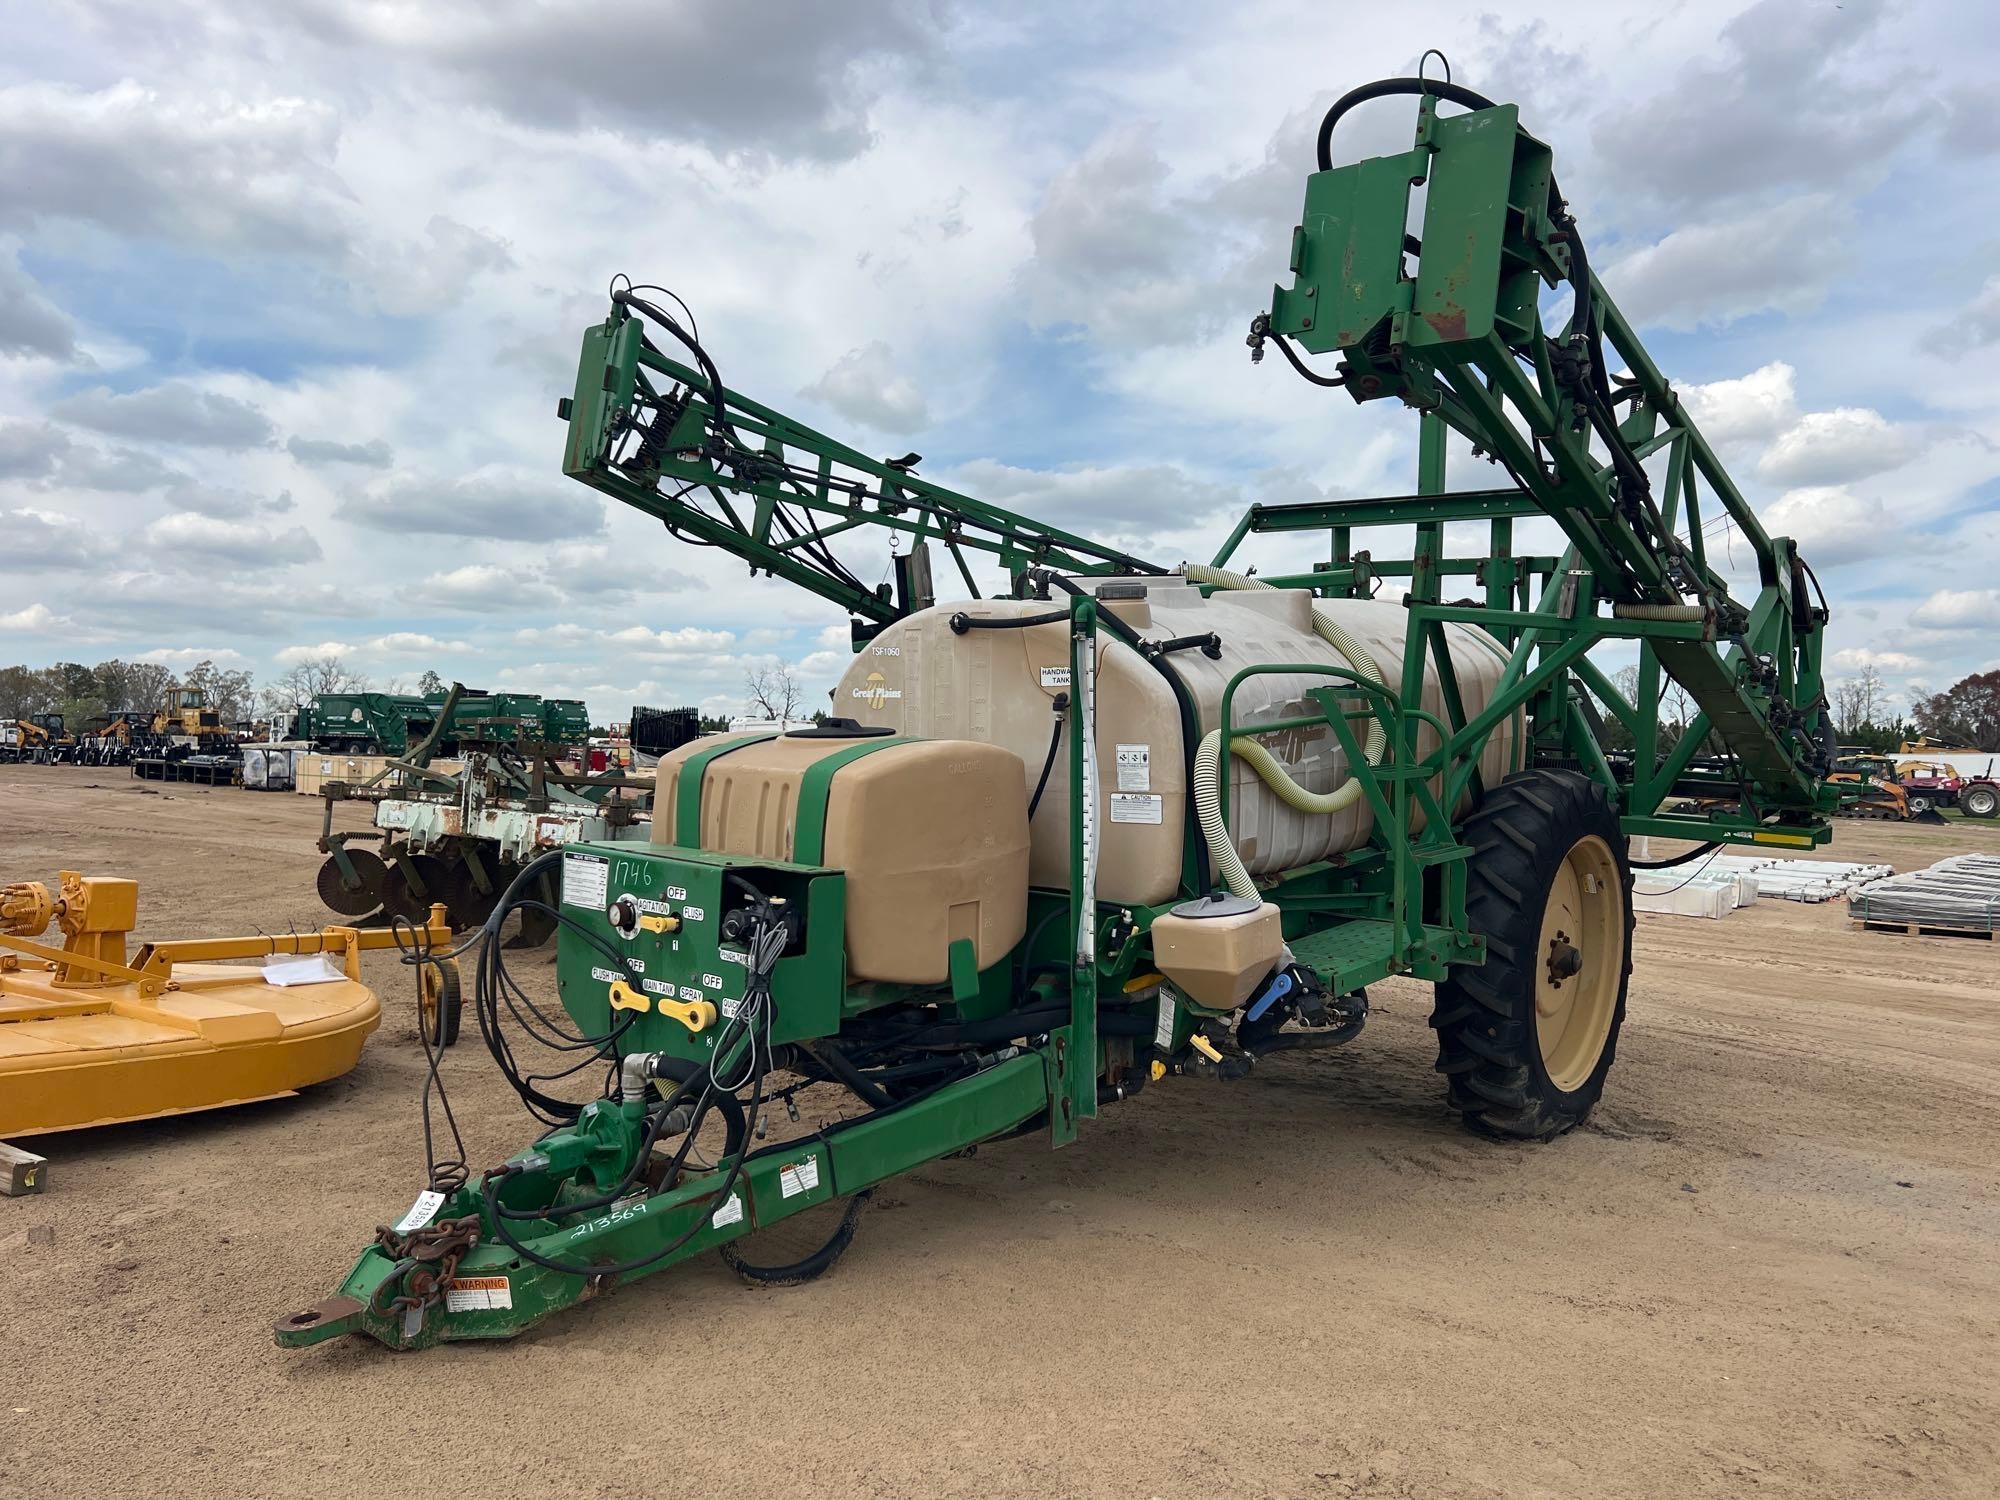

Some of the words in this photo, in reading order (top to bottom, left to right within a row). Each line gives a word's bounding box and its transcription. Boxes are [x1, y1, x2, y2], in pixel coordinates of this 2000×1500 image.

[852, 687, 875, 698] Great
[876, 687, 902, 698] Plains
[614, 859, 652, 887] 1746
[668, 887, 685, 900] OFF
[638, 899, 669, 914] AGITATION
[684, 906, 703, 920] FLUSH
[628, 959, 644, 972] OFF
[593, 967, 609, 979] FLUSH
[643, 979, 658, 991] MAIN
[659, 983, 675, 996] TANK
[704, 974, 721, 988] OFF
[680, 987, 703, 1002] SPRAY
[570, 1203, 647, 1240] 213569
[460, 1279, 506, 1290] WARNING
